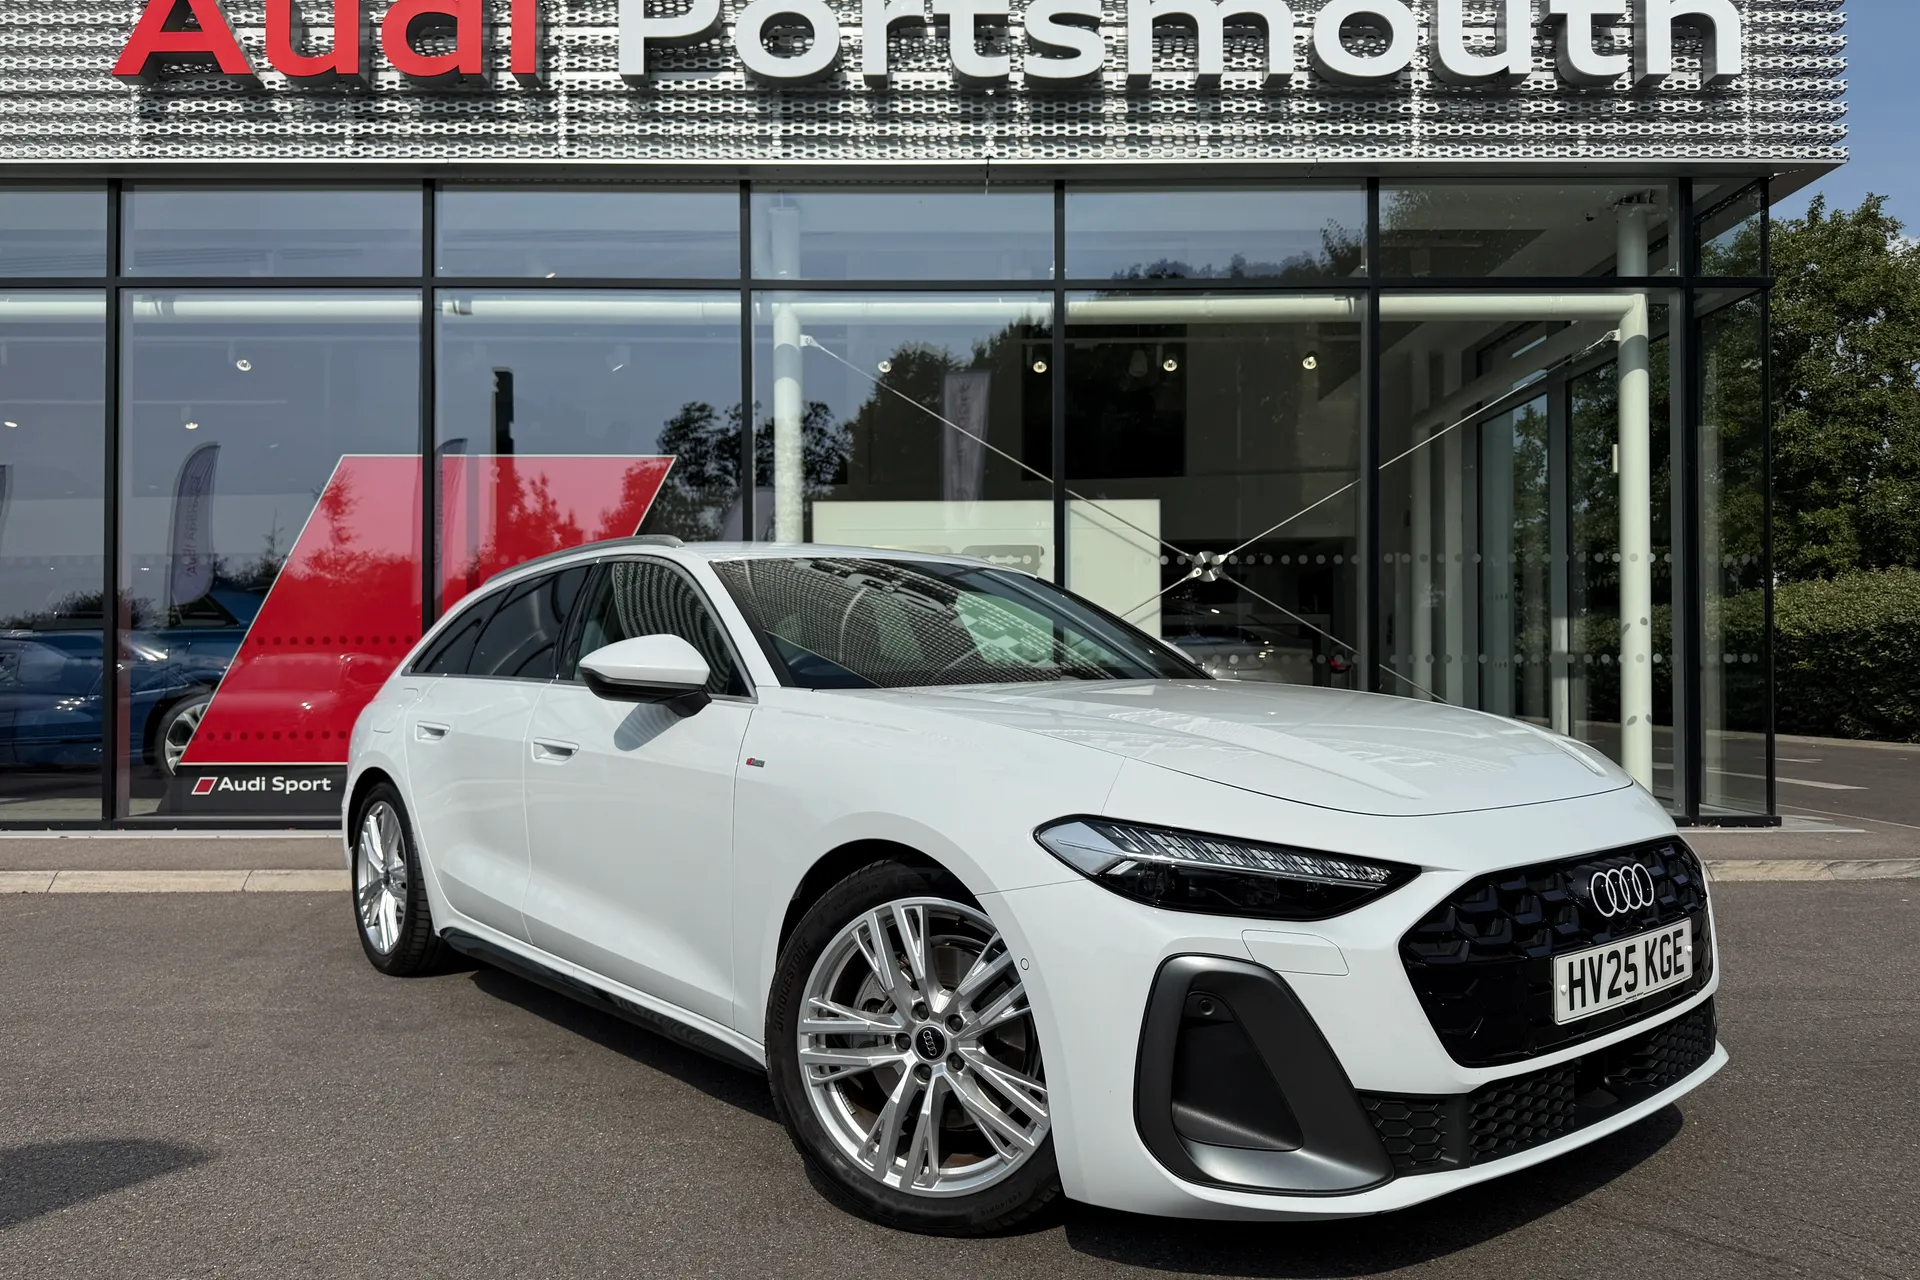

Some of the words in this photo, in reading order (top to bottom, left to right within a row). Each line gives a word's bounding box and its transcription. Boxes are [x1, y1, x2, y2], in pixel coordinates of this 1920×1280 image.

[111, 0, 538, 78] Audi
[618, 0, 1742, 78] Portsmouth
[217, 776, 266, 792] Audi
[271, 776, 332, 795] Sport
[773, 936, 812, 1034] BRIDGESTONE
[1568, 944, 1638, 1011] HV25
[1644, 928, 1685, 987] KGE
